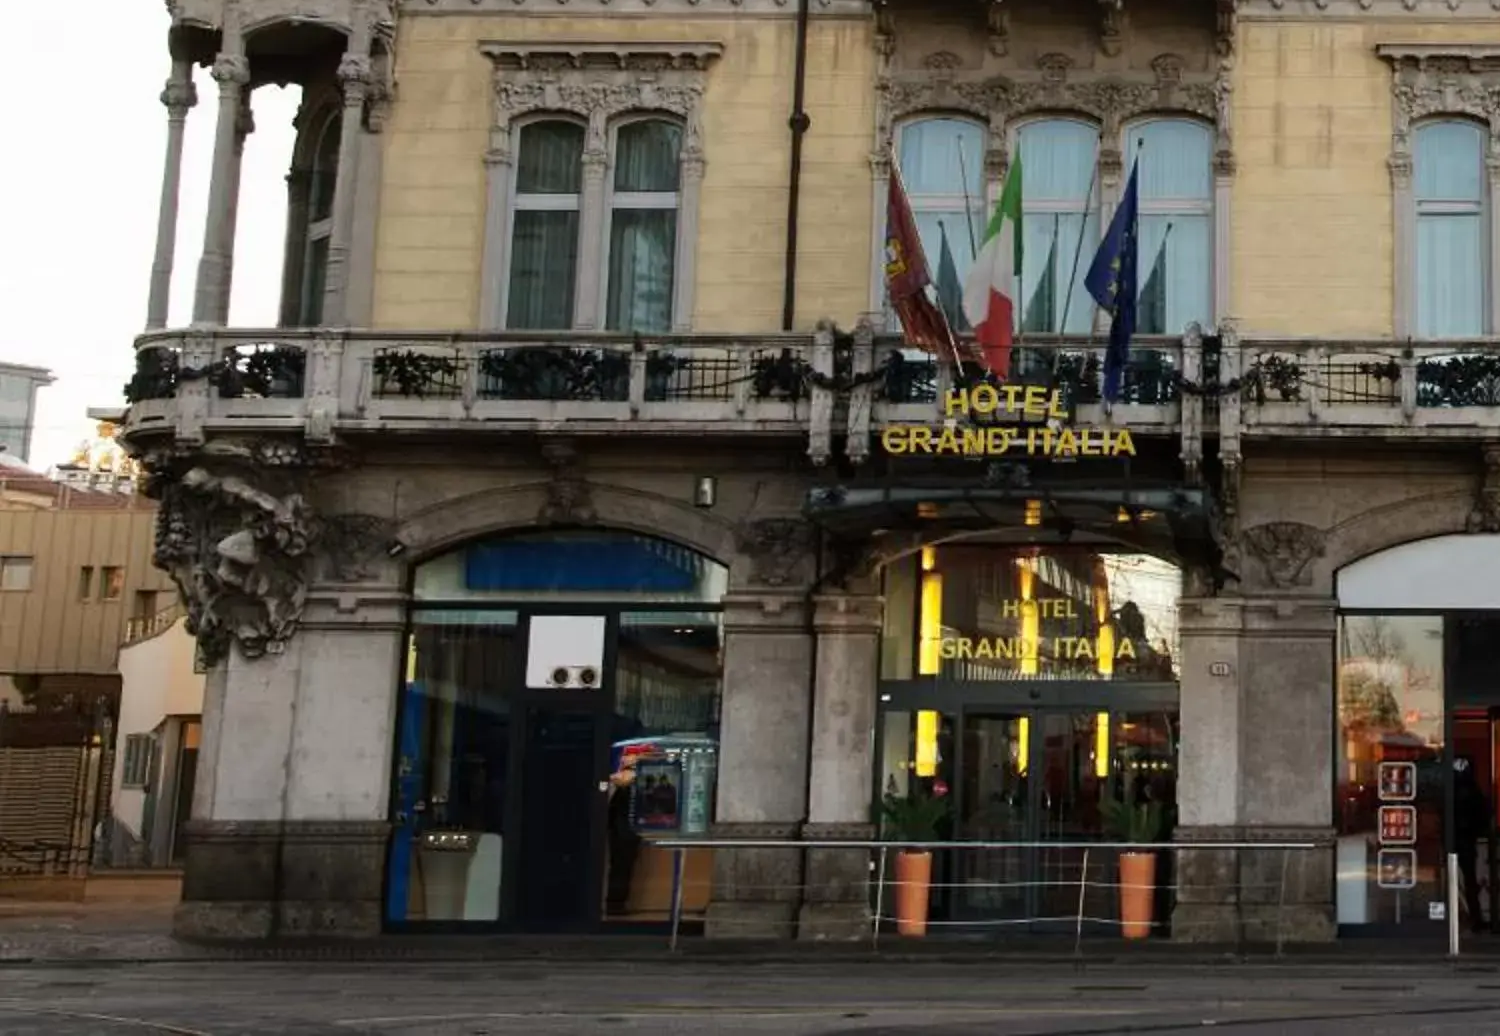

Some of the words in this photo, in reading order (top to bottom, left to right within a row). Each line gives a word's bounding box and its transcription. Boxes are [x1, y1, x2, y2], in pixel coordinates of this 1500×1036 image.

[944, 383, 1069, 418] HOTEL
[1028, 427, 1137, 456] ITALIA
[1002, 598, 1078, 619] HOTEL
